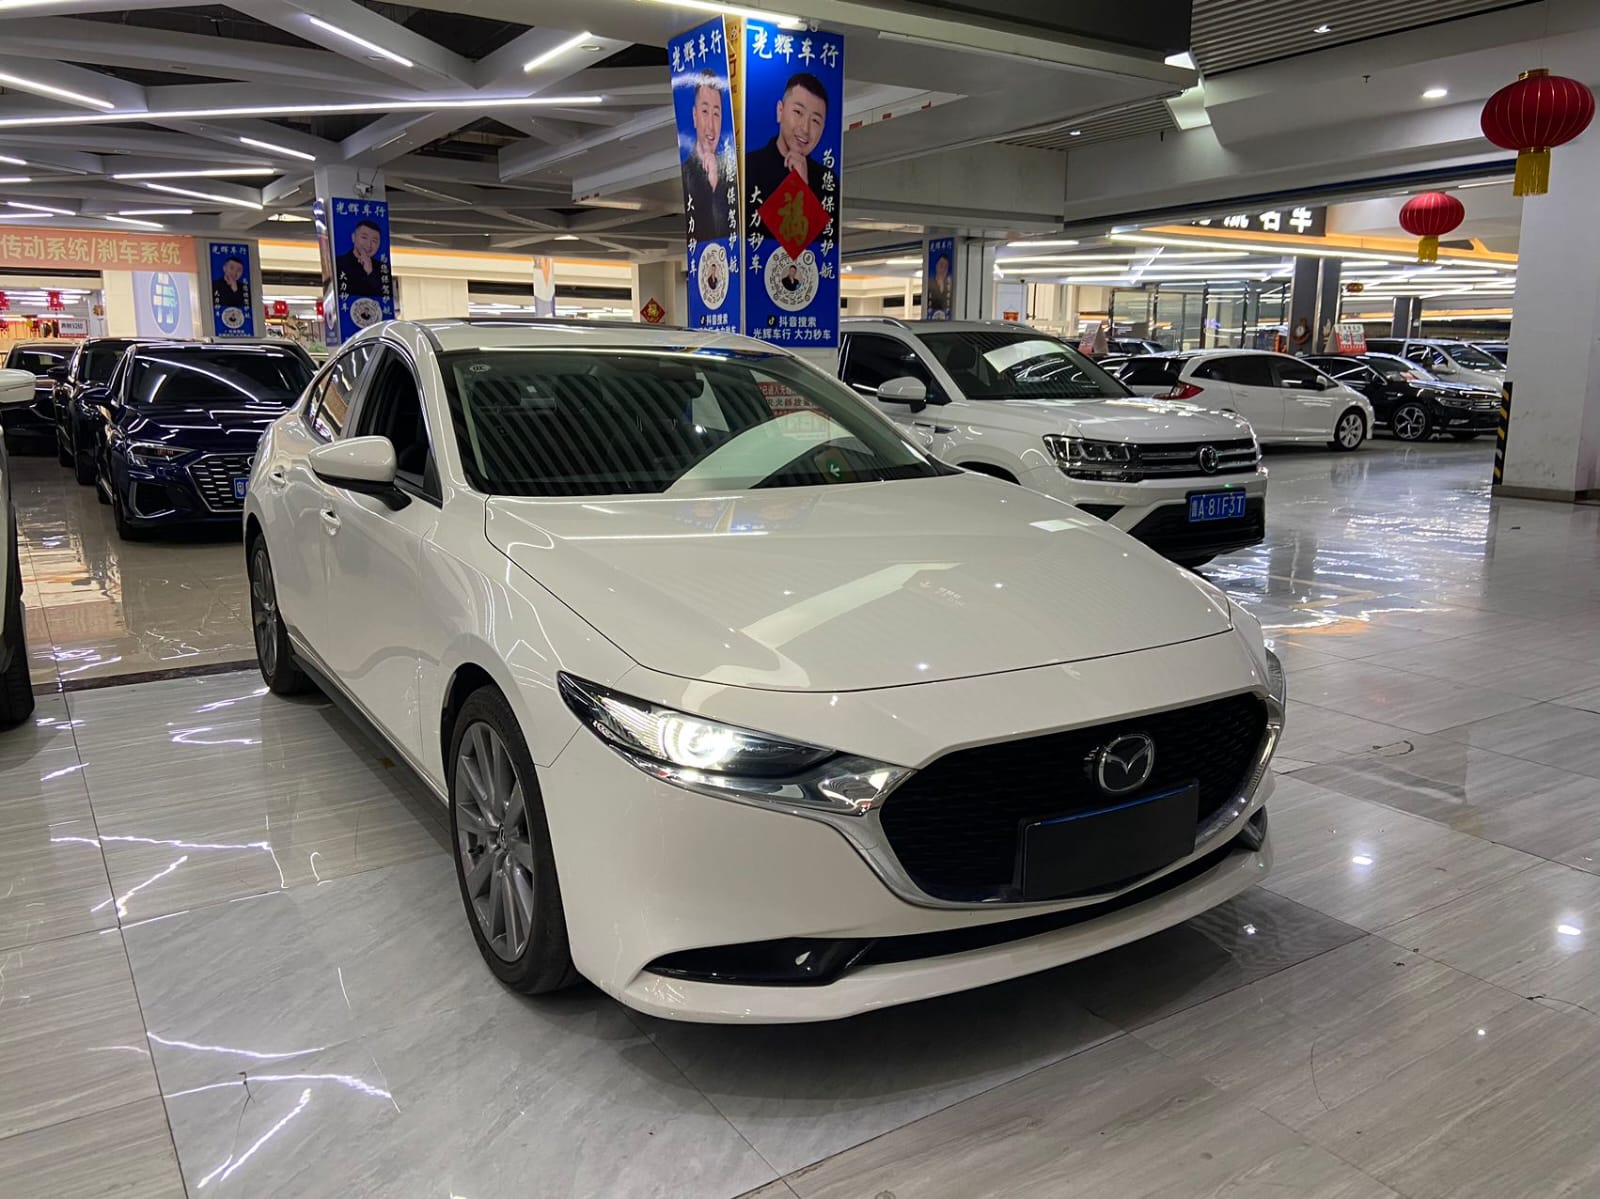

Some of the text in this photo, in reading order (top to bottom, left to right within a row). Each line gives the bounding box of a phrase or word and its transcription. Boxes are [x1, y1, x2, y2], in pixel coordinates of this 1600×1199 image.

[672, 28, 723, 73] 光辉车行
[752, 30, 839, 69] 光辉车行
[336, 201, 386, 218] 光辉车行
[777, 191, 809, 246] 福
[1, 234, 182, 265] 传动系统/刹车系统
[686, 193, 698, 277] 大力秒车
[748, 185, 764, 275] 大力秒车
[753, 328, 832, 340] 光辉车行 大力秒车
[779, 316, 817, 328] 抖音搜索
